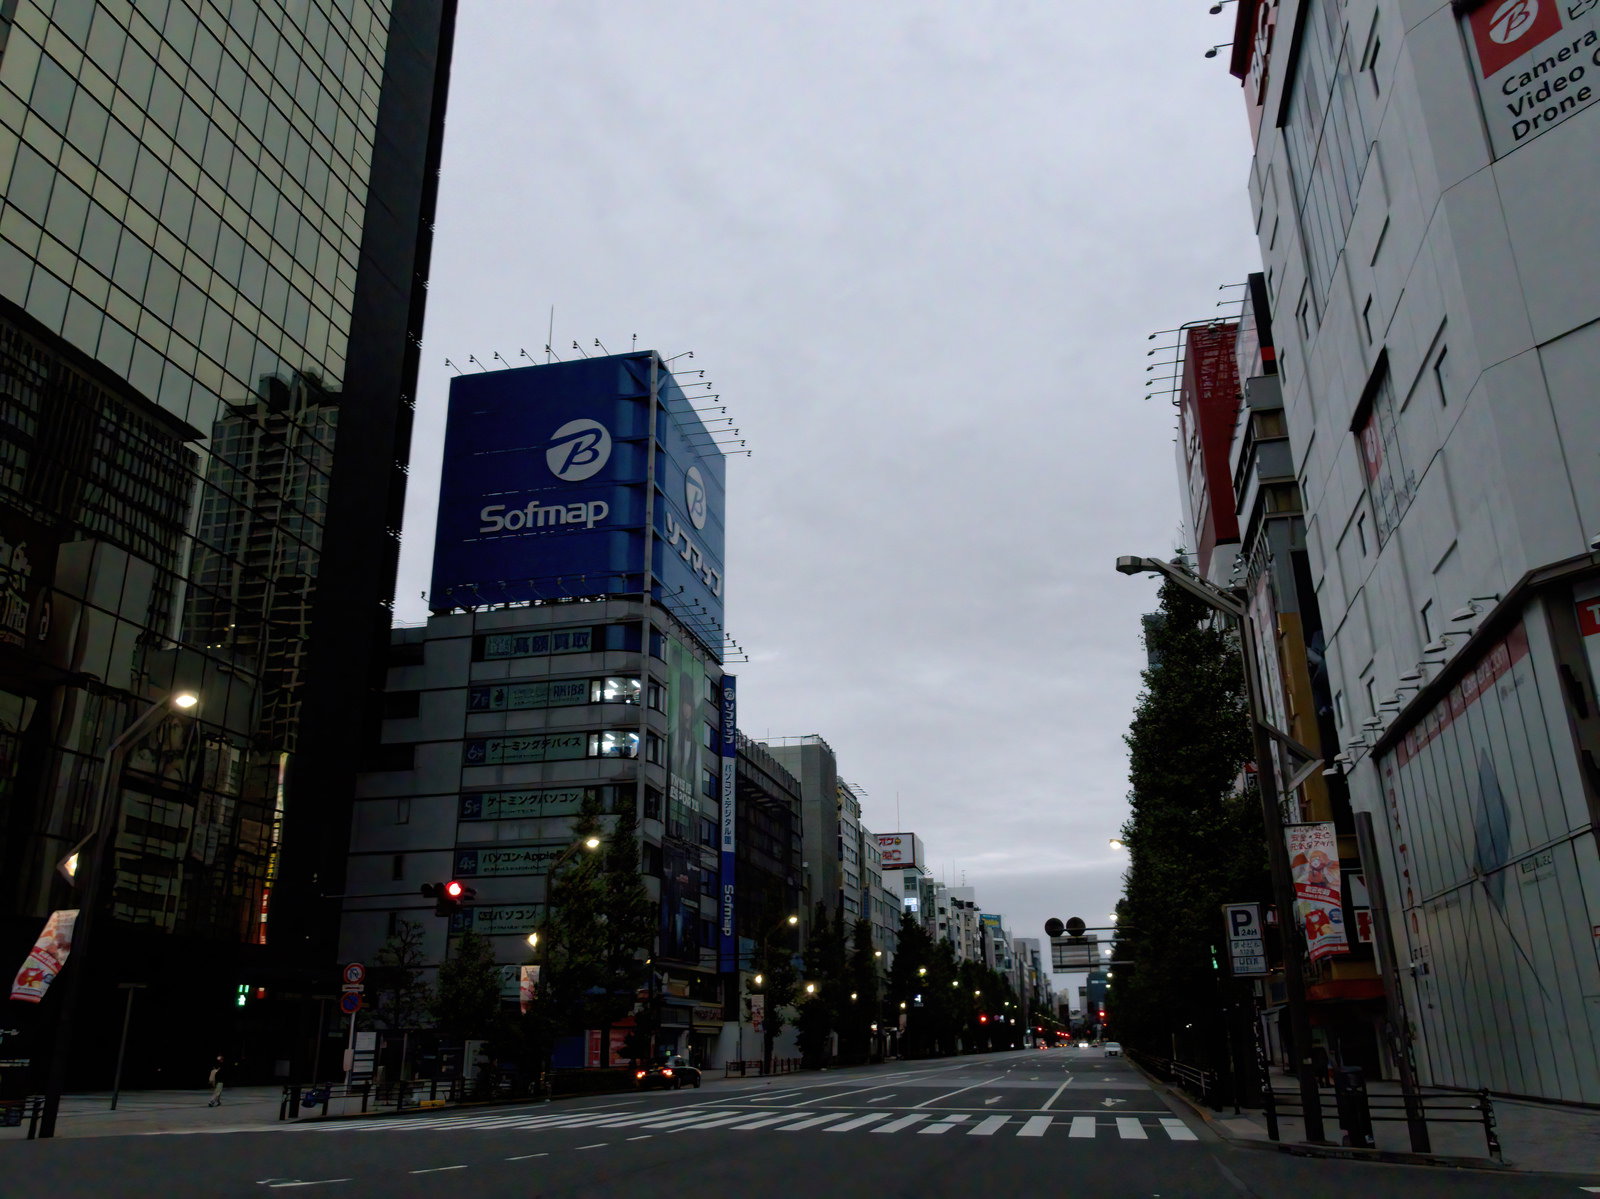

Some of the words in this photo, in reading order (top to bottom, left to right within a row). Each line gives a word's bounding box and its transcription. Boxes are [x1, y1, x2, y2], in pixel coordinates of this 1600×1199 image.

[1502, 30, 1597, 95] Camera
[1507, 66, 1585, 117] Video
[1512, 86, 1591, 141] Drone
[480, 501, 609, 533] Sofmap
[666, 512, 721, 597] ソフマップ
[491, 738, 581, 752] ゲーミングデバイス
[487, 793, 578, 807] ゲーミングパソコン
[724, 884, 734, 936] Sofmap
[1231, 909, 1252, 936] P
